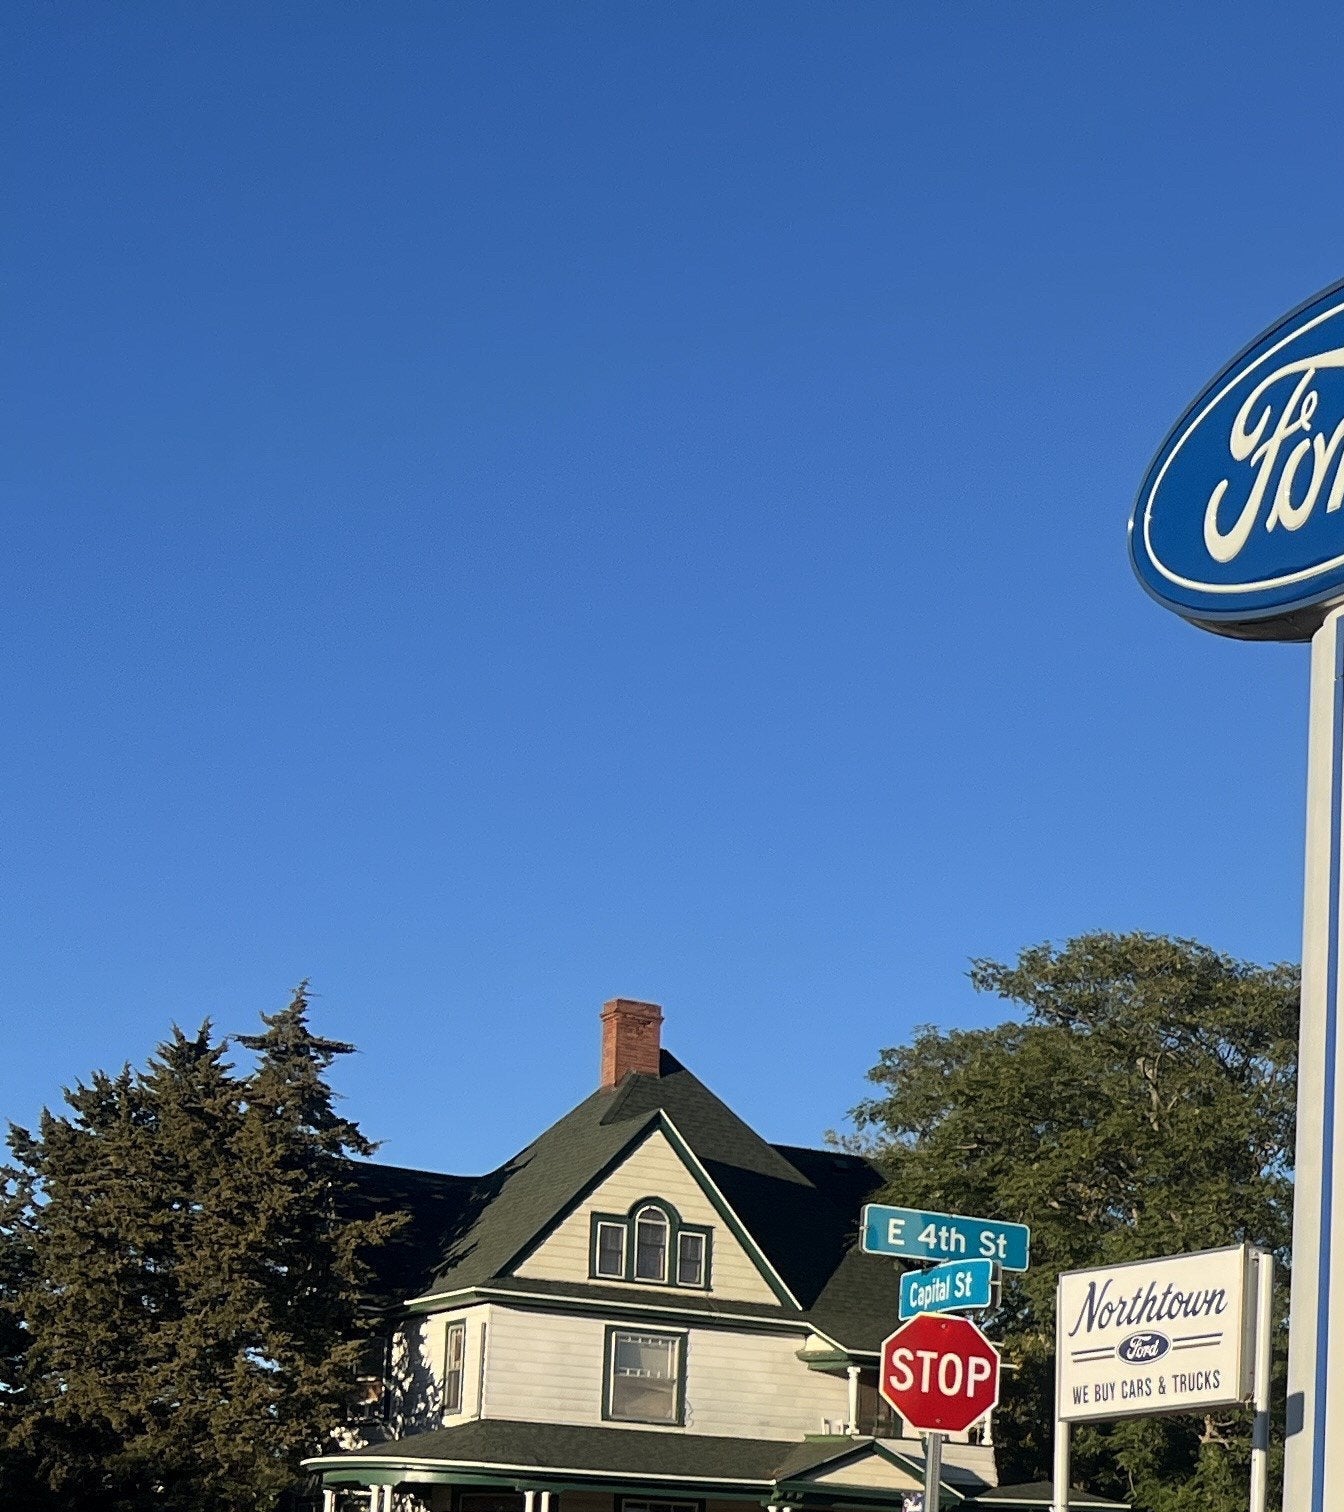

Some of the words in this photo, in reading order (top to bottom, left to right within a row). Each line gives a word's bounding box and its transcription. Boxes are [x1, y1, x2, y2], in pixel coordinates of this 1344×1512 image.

[887, 1217, 906, 1246] E
[917, 1223, 966, 1254] 4th
[979, 1230, 1008, 1259] St
[909, 1275, 950, 1310] Capital
[953, 1270, 973, 1299] St
[1068, 1278, 1229, 1337] Northtown
[1126, 1335, 1159, 1361] Ford
[889, 1347, 992, 1398] STOP
[1073, 1385, 1089, 1405] WE
[1094, 1381, 1116, 1402] BUY
[1121, 1377, 1152, 1399] CARS
[1158, 1376, 1167, 1395] &
[1172, 1369, 1221, 1393] TRUCKS
